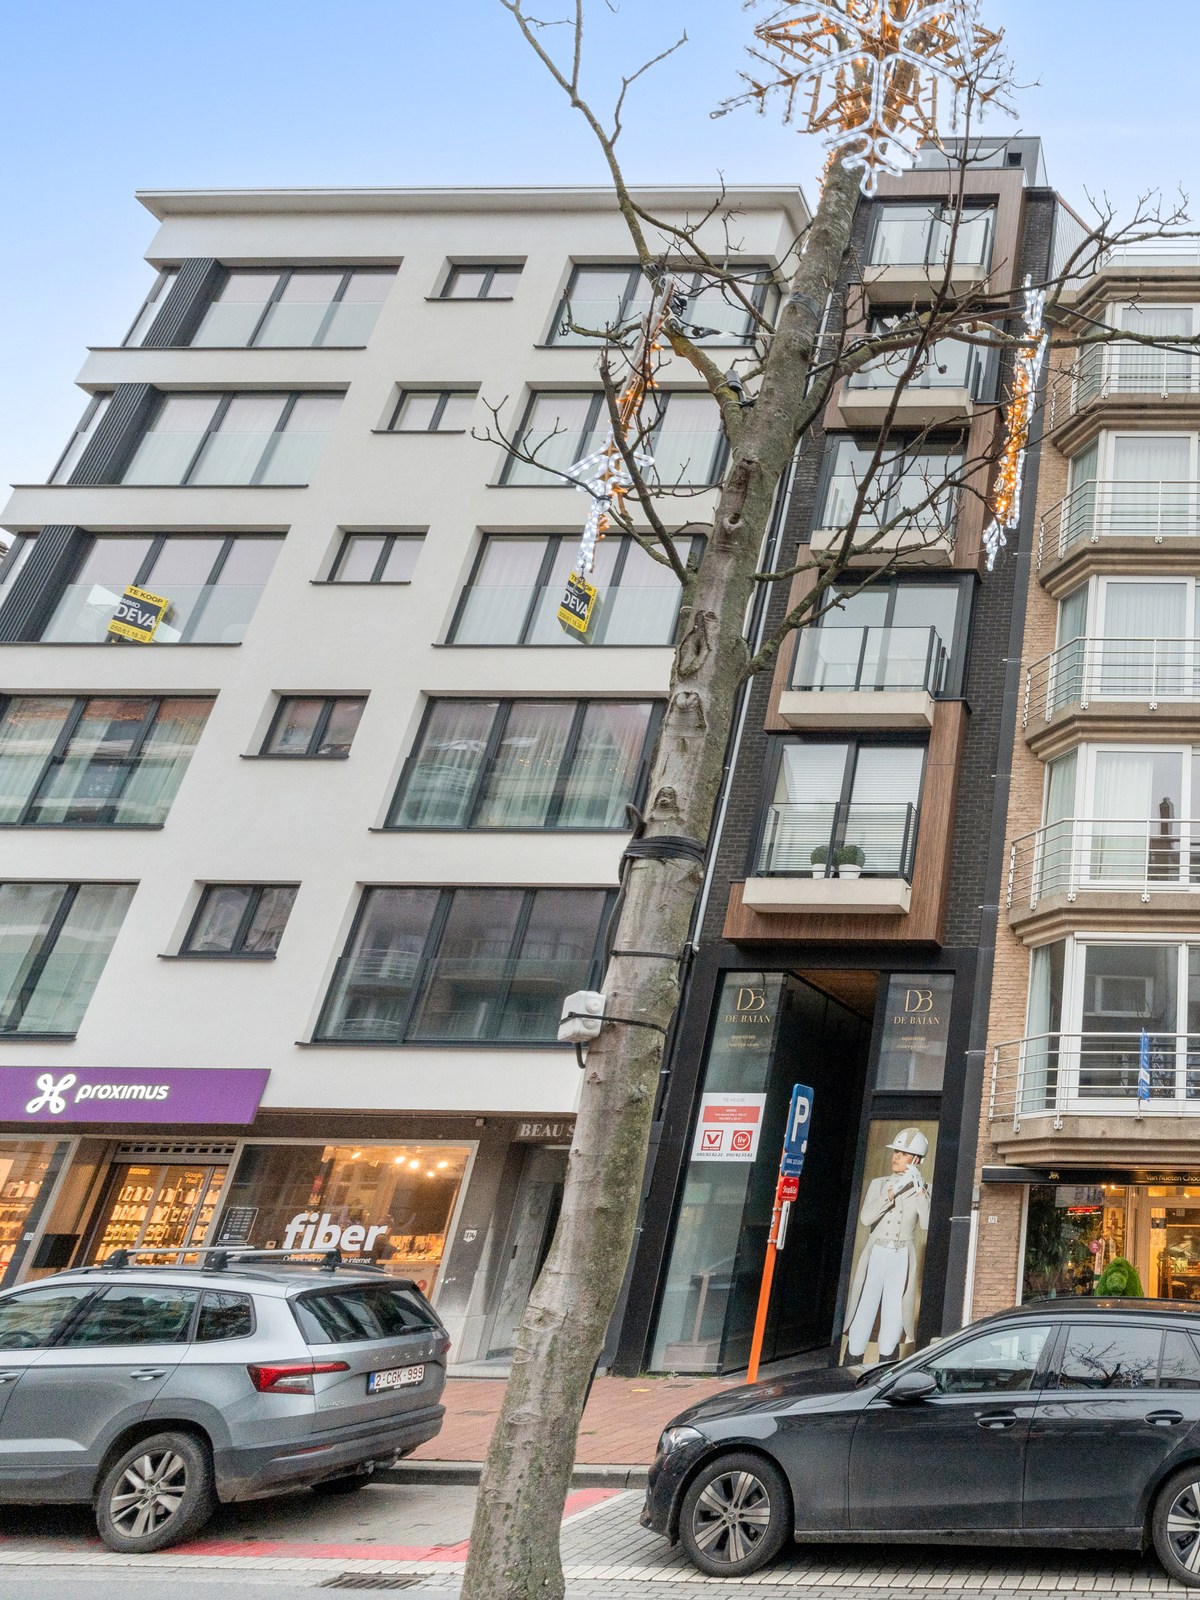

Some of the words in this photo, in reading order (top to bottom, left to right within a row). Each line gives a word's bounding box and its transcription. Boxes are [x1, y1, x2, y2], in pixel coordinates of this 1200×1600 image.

[129, 587, 139, 596] TE
[140, 592, 164, 604] KOOP
[562, 590, 588, 617] DEVA
[114, 603, 157, 629] DEVA
[724, 1014, 739, 1023] DE
[893, 1016, 908, 1025] DE
[74, 1083, 170, 1104] proximus
[790, 1095, 810, 1142] P
[520, 1123, 564, 1137] BEAU
[1146, 1174, 1160, 1182] Van
[1160, 1174, 1182, 1182] Nueten
[281, 1211, 389, 1252] fiber
[375, 1366, 424, 1388] 2-CGK-999
